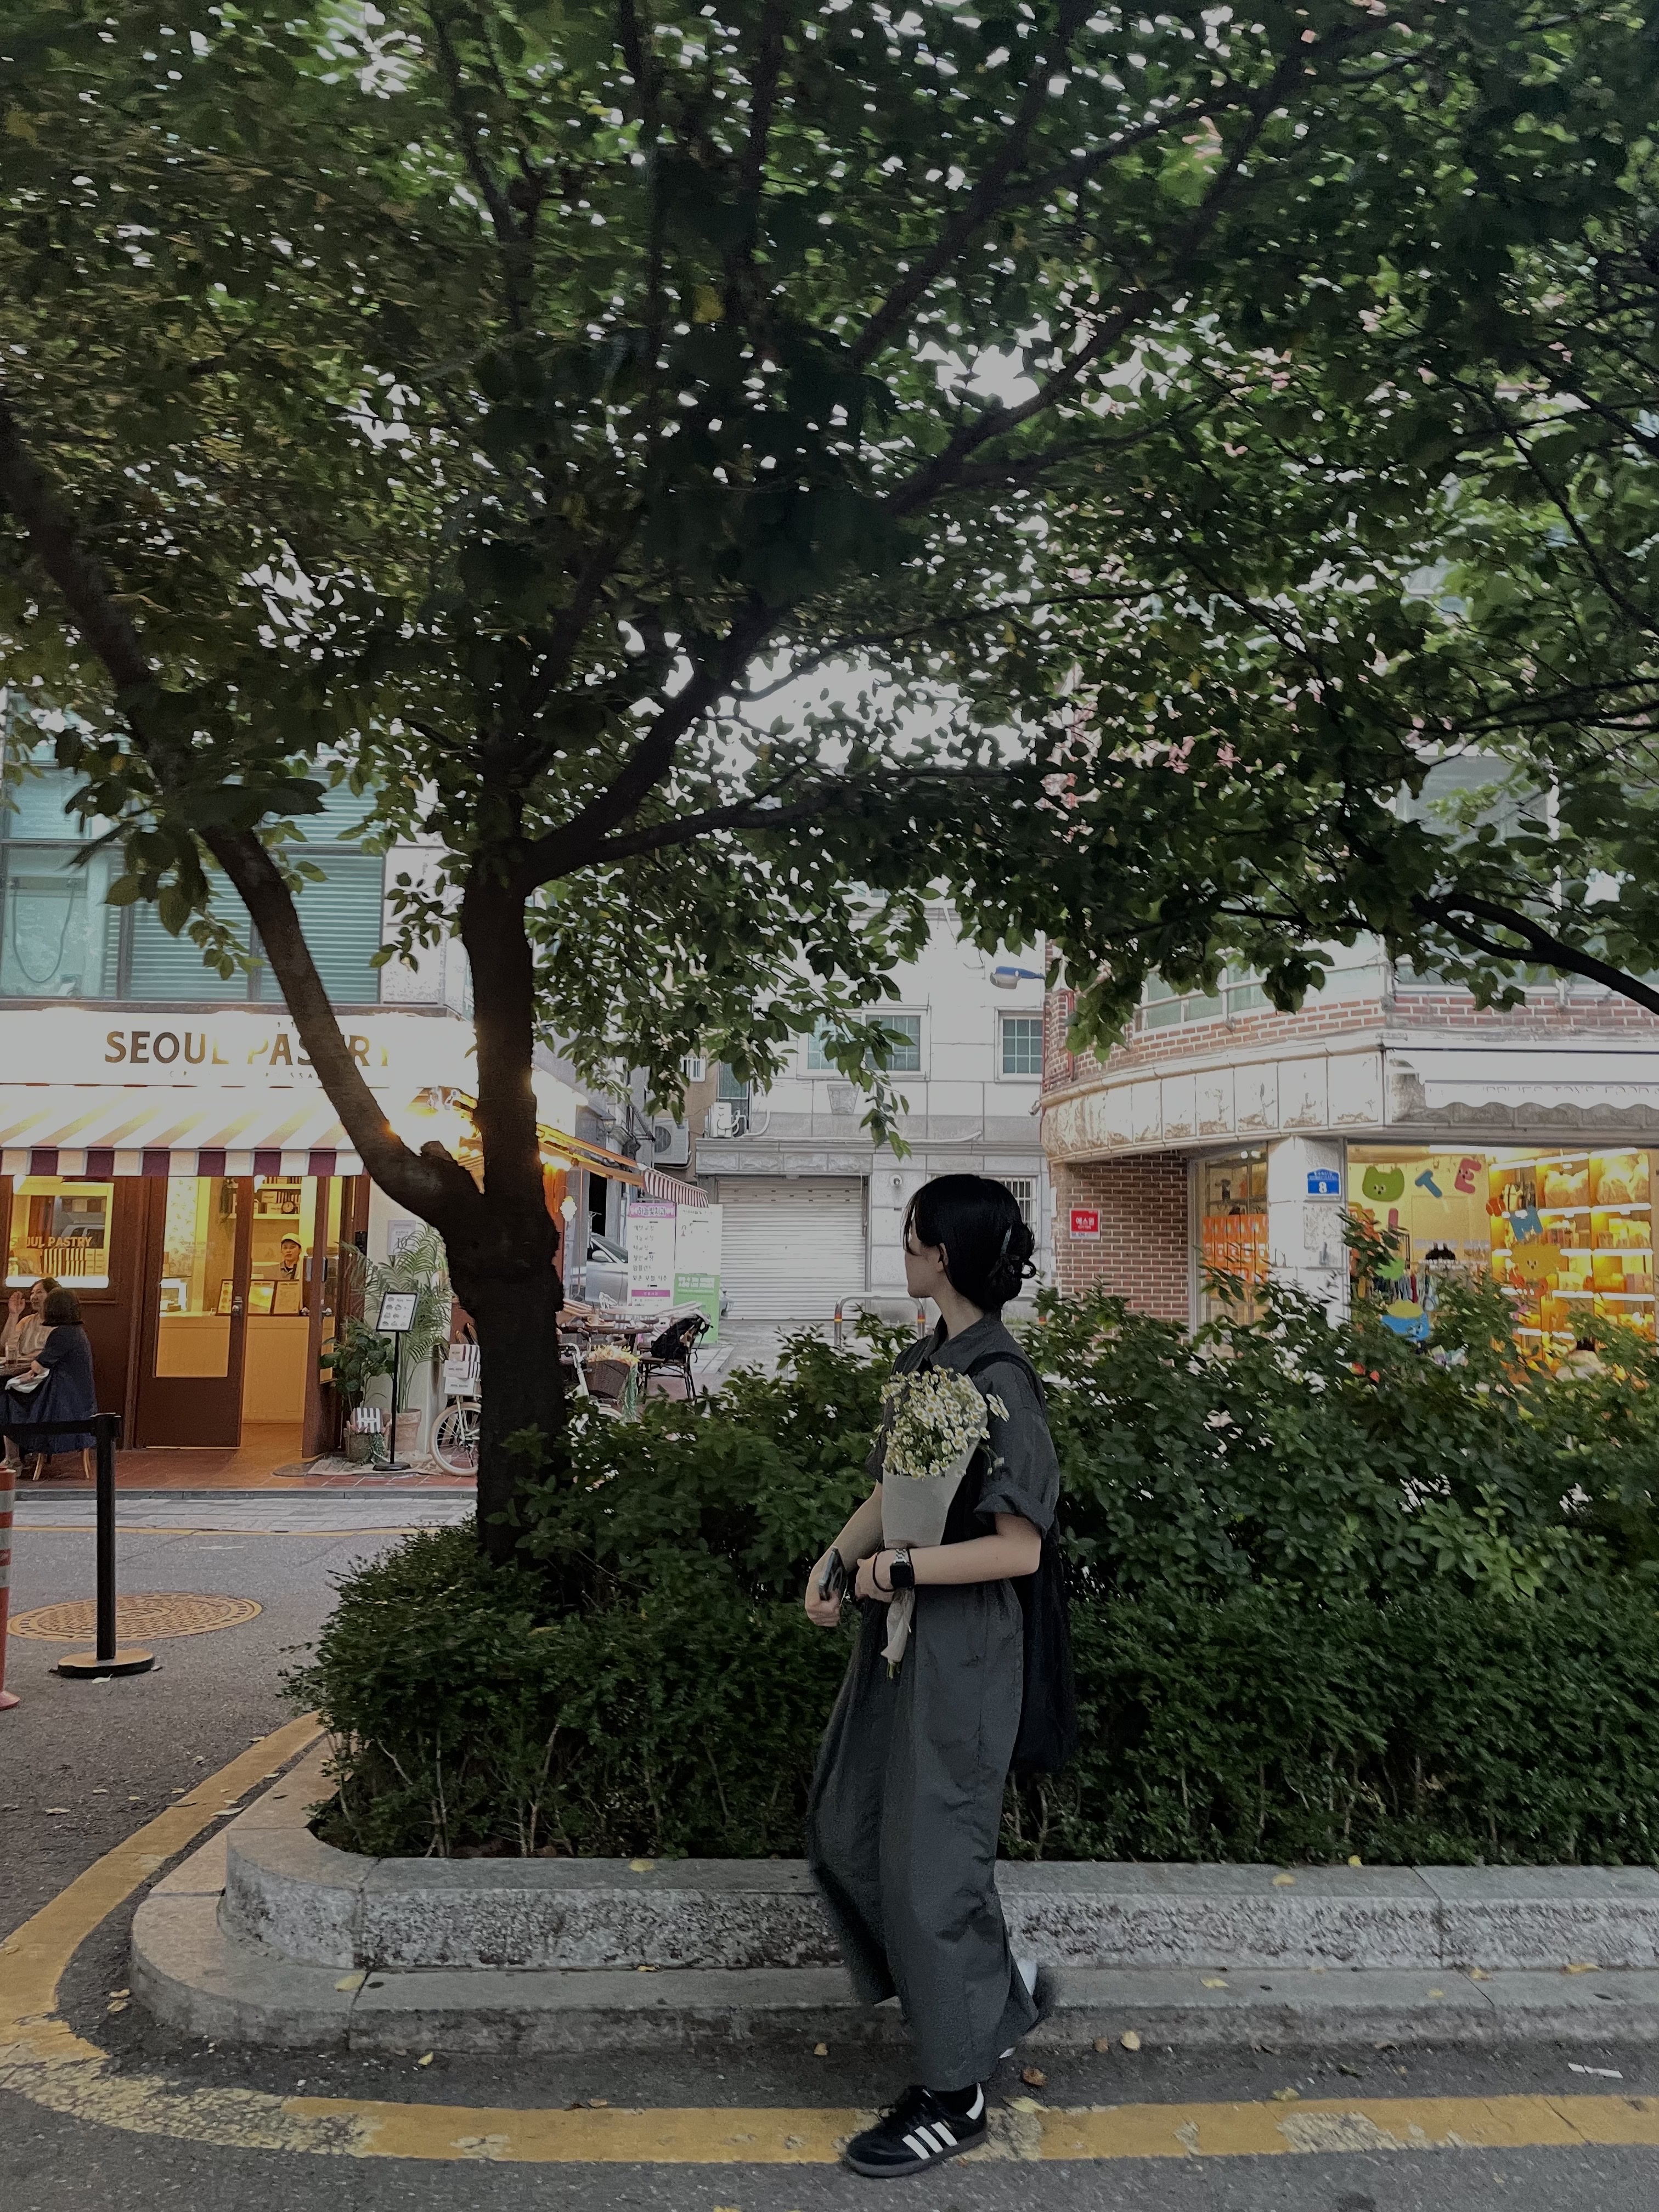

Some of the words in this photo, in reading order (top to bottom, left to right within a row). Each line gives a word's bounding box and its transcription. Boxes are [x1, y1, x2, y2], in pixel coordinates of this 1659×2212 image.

[105, 1031, 229, 1064] SEOUL
[247, 1034, 388, 1066] PAR
[1318, 1182, 1327, 1193] 8
[1075, 1217, 1094, 1226] 에스원
[11, 1236, 45, 1248] SUL
[48, 1237, 93, 1248] PASTRY
